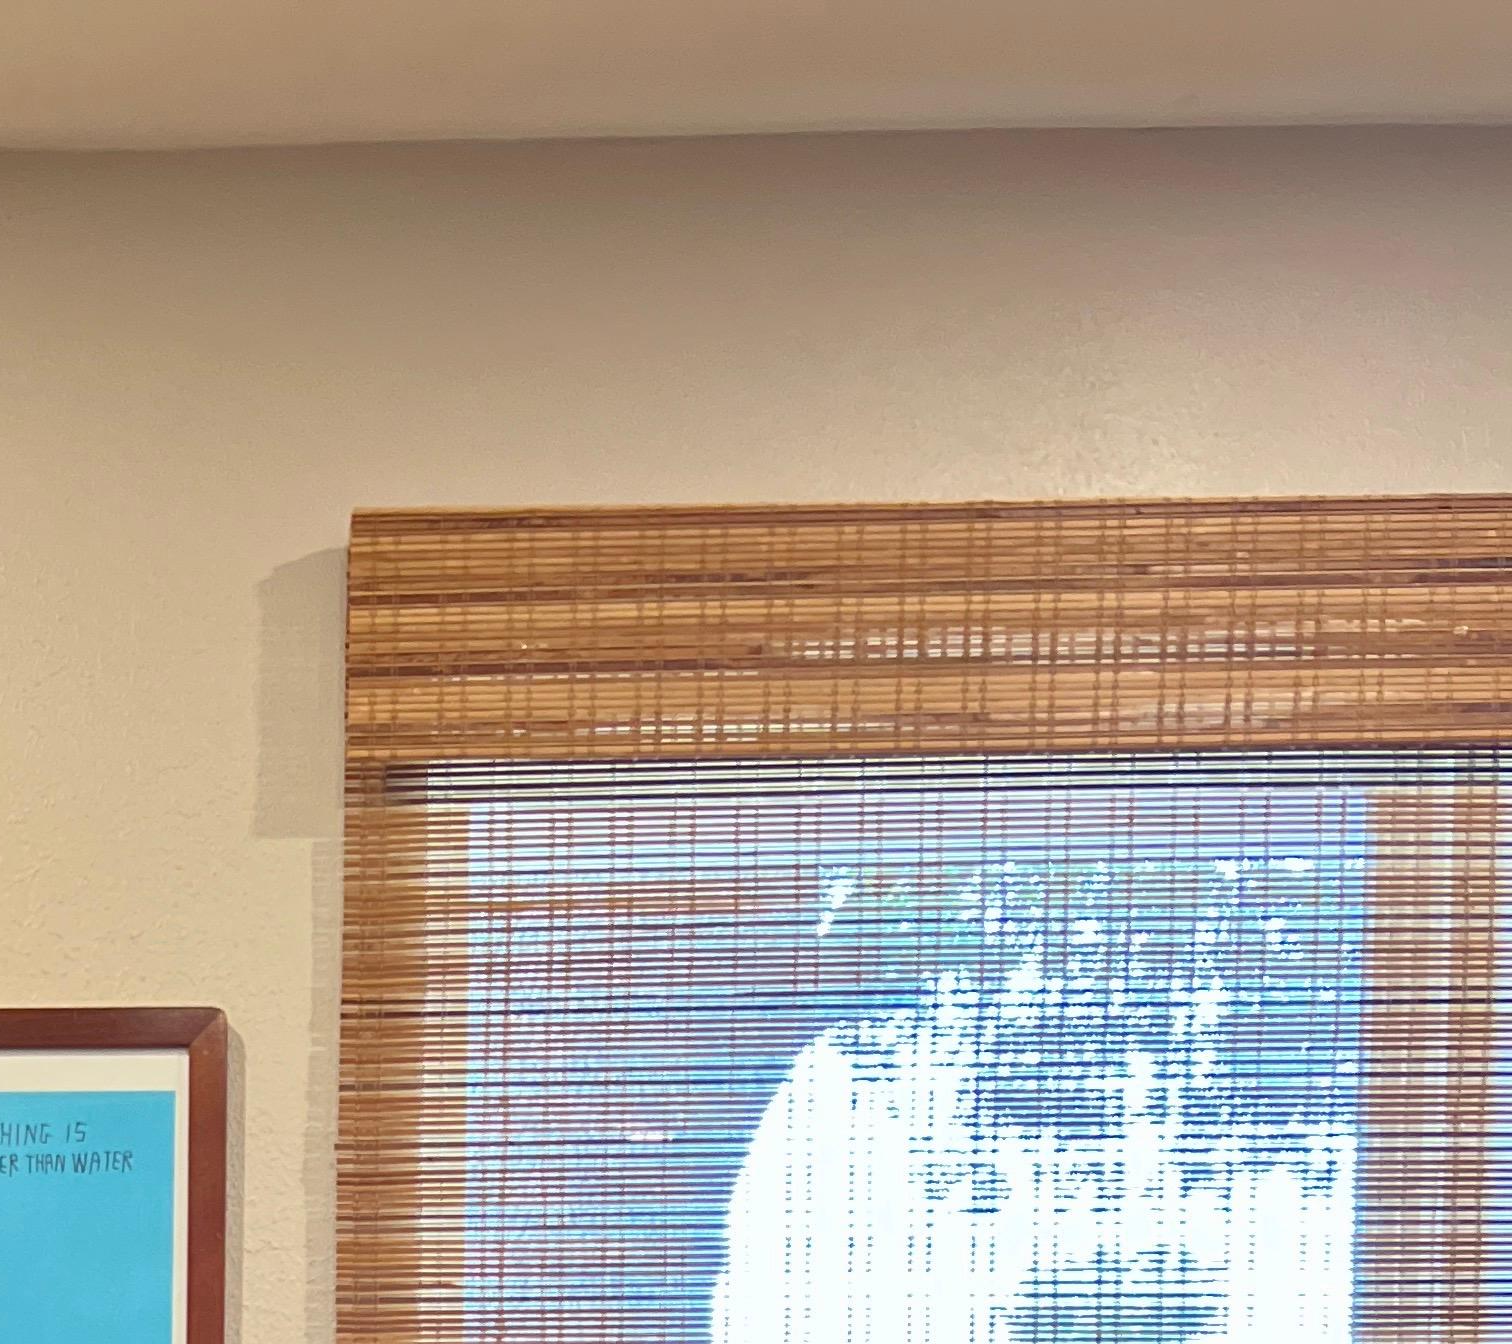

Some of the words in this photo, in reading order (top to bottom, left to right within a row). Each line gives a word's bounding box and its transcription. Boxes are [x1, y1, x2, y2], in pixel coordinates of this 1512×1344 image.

[66, 1121, 89, 1144] IS
[26, 1152, 66, 1175] THAN
[71, 1150, 134, 1175] WATER
